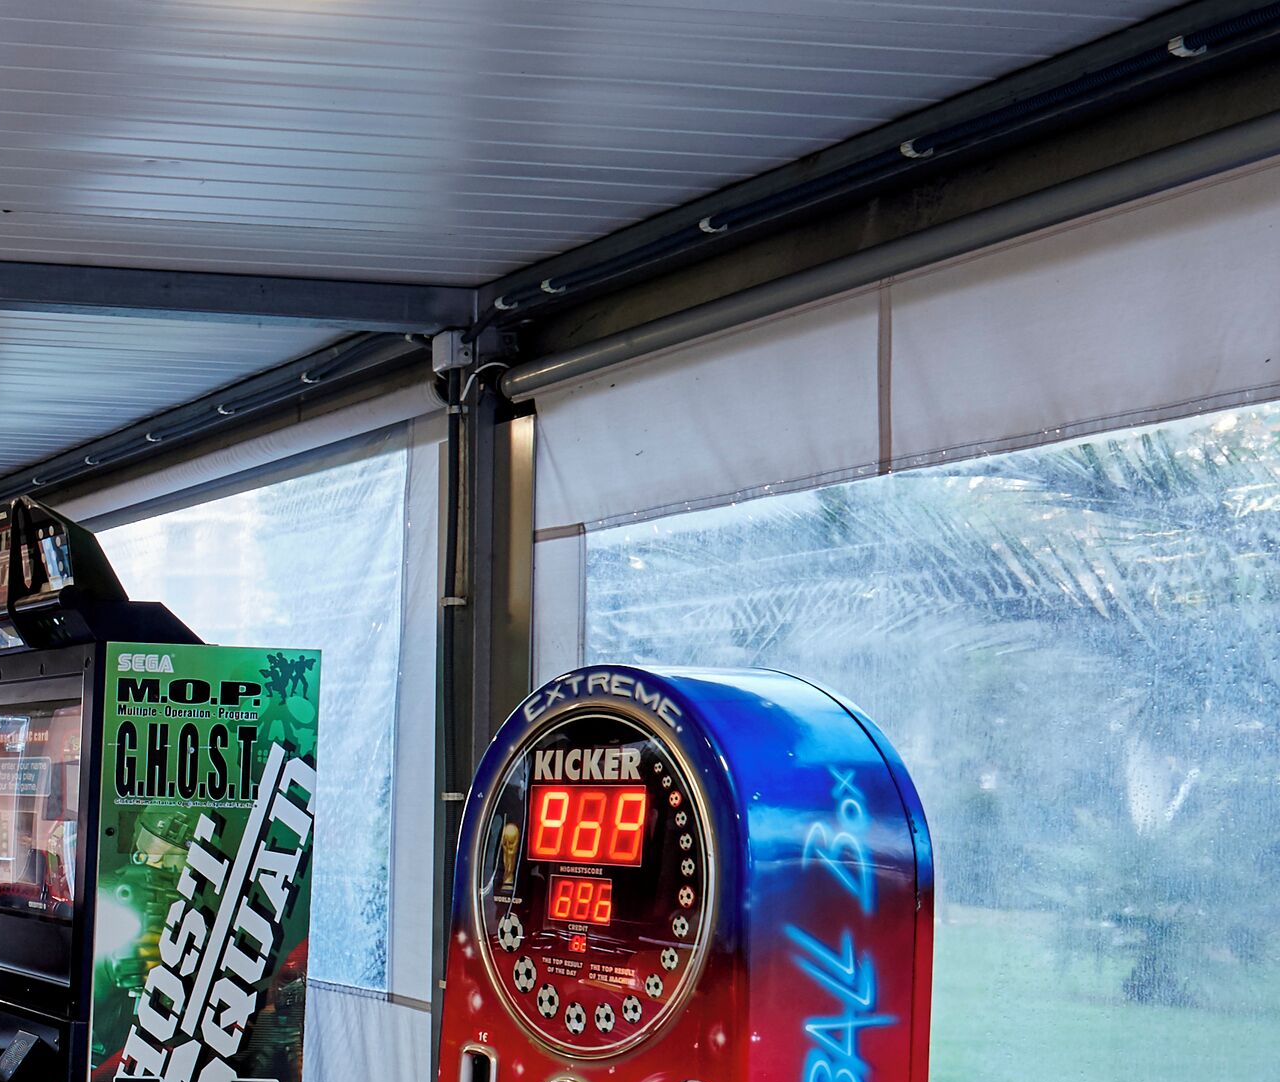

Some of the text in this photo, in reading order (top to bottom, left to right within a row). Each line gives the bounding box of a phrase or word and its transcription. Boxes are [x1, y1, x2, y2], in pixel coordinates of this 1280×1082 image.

[117, 653, 174, 673] SEGA
[117, 677, 262, 707] M.O.P.
[523, 672, 683, 727] EXTREME
[117, 704, 258, 720] Multiple Operation Program
[115, 720, 259, 800] G.H.O.S.T.
[534, 747, 642, 781] KICKER
[559, 865, 603, 875] HIGHESTSCORE
[568, 924, 589, 932] CREDIT
[542, 956, 552, 964] THE
[564, 960, 583, 968] RESULT
[566, 969, 577, 977] DAY
[590, 963, 636, 976] THE TOP RESULT
[589, 972, 597, 980] OF
[597, 974, 608, 982] THE
[478, 1031, 488, 1043] 1€
